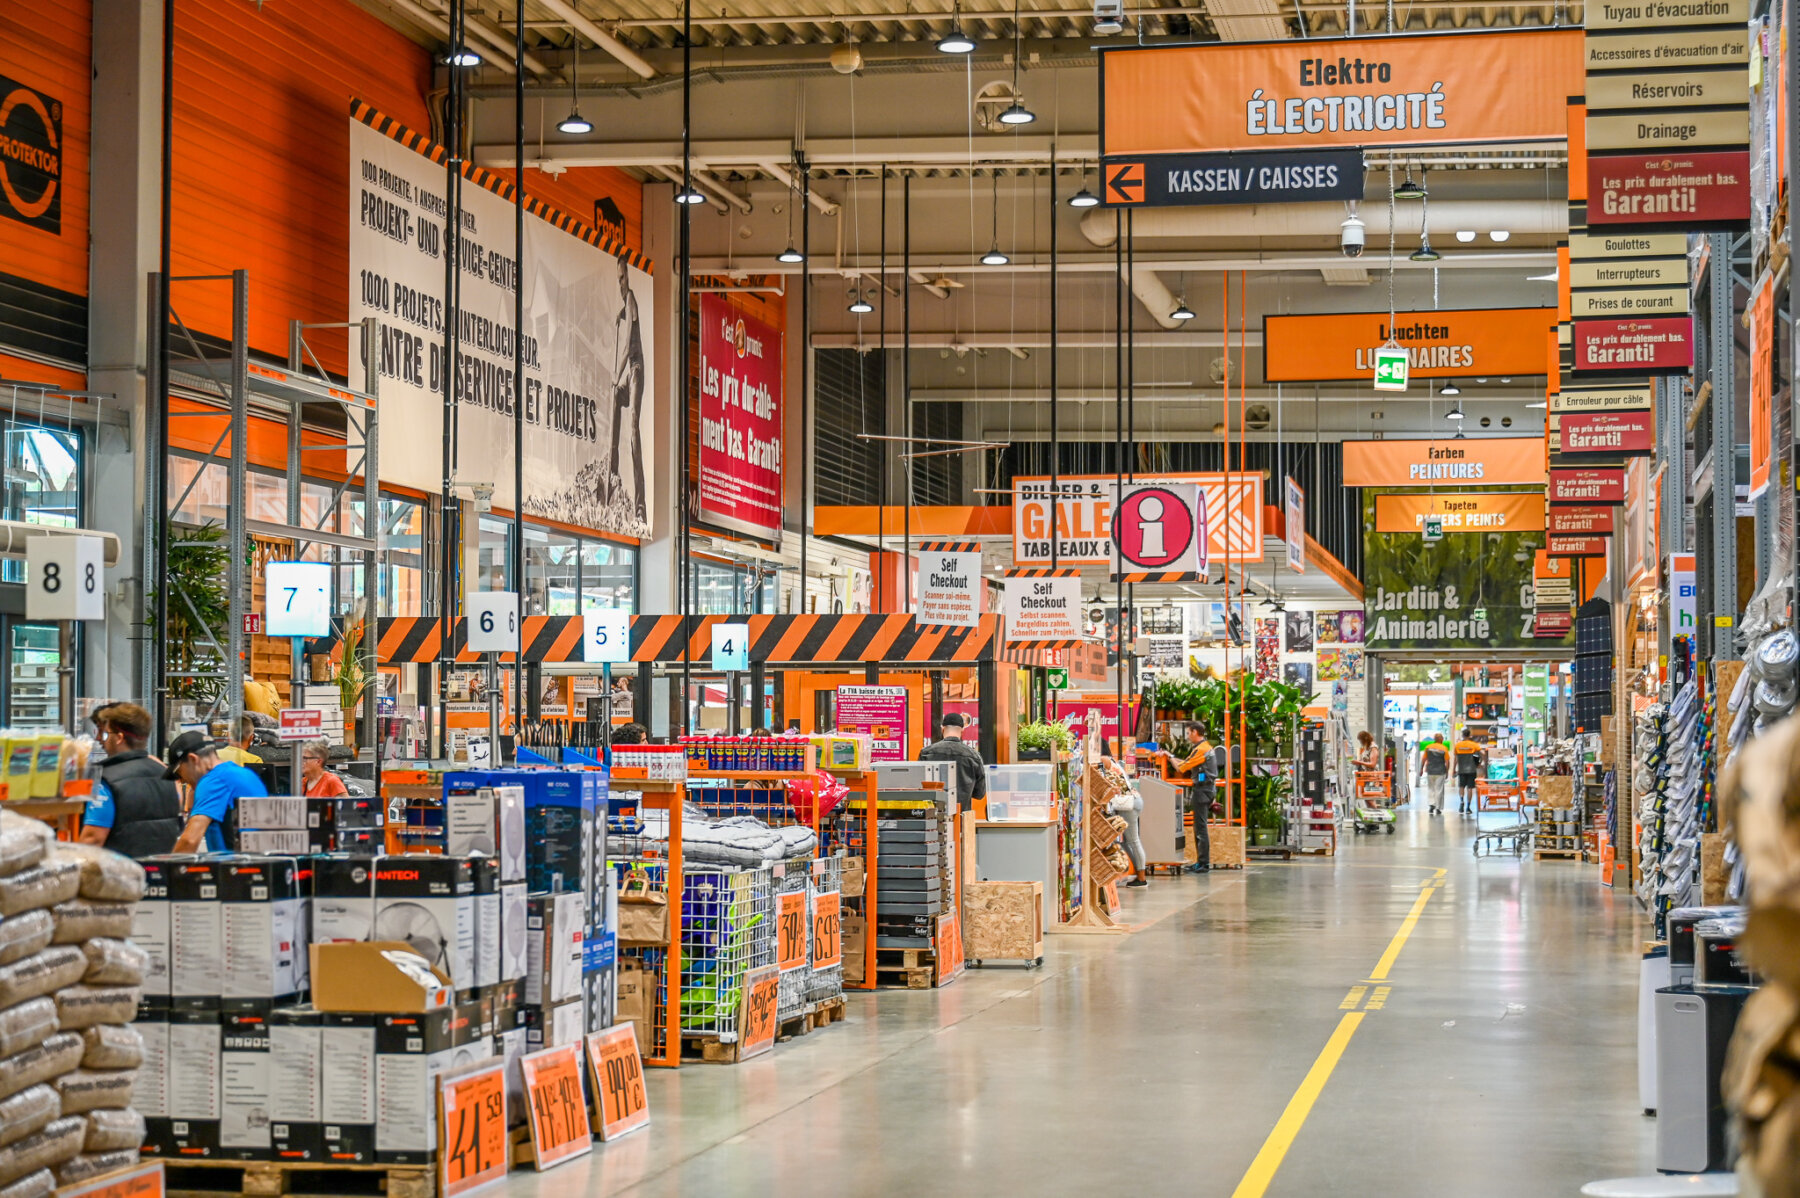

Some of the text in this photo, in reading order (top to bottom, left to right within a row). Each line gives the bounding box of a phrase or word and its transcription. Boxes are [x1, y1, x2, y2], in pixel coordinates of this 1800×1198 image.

[1603, 2, 1729, 22] Tuyau d'évacuation
[1590, 43, 1744, 61] Accessoires d'évacuation d'air
[1299, 57, 1391, 86] Elektro
[1632, 83, 1703, 99] Réservoirs
[1246, 81, 1446, 135] ÉLECTRICITÉ
[1637, 123, 1697, 140] Drainage
[361, 159, 378, 184] 1000
[379, 167, 412, 201] PROJEKTE.
[1167, 165, 1338, 193] KASSEN / CAISSES
[1603, 173, 1738, 191] Les prix durablement bas.
[1603, 187, 1696, 215] Garanti!
[361, 188, 414, 245] PROJEKT-
[417, 215, 439, 259] UND
[1605, 239, 1651, 251] Goulottes
[1596, 268, 1660, 280] Interrupteurs
[360, 269, 389, 313] 1000
[394, 282, 446, 334] PROJETS.
[1588, 296, 1674, 309] Prises de courant
[1379, 323, 1449, 341] Leuchten
[1586, 333, 1685, 346] Les prix durablement bas.
[1355, 345, 1473, 370] LUNAIRES
[1587, 344, 1655, 364] Garanti!
[702, 354, 777, 421] Les prix durable-
[1566, 396, 1602, 406] Enrouleur
[1604, 397, 1621, 406] pour
[1623, 394, 1644, 404] câble
[526, 377, 542, 423] ET
[547, 384, 597, 442] PROJETS
[1568, 425, 1580, 433] Les
[1581, 425, 1593, 434] prix
[702, 416, 780, 475] ment bas. Garanti!
[1569, 431, 1622, 447] Garanti!
[1428, 447, 1465, 459] Farben
[1409, 462, 1484, 479] PEINTURES
[1557, 484, 1600, 497] Garanti!
[1443, 500, 1477, 512] Tapeten
[1465, 512, 1505, 526] PEINTS
[1555, 519, 1592, 530] Garanti!
[1551, 541, 1585, 551] Garanti!
[941, 558, 957, 572] Self
[1547, 557, 1560, 574] 4
[42, 562, 95, 593] 8 8
[930, 573, 968, 589] Checkout
[924, 590, 945, 601] Scanner
[1034, 582, 1053, 595] Self
[283, 587, 297, 612] 7
[922, 600, 973, 613] Payer sans espèces.
[1021, 596, 1067, 609] Checkout
[1374, 585, 1460, 611] Jardin &
[480, 611, 515, 633] 6 6
[924, 611, 935, 620] Plus
[936, 612, 946, 621] vite
[953, 613, 969, 622] projet.
[1020, 611, 1039, 619] Selbst
[1011, 629, 1038, 637] Schneller
[1053, 628, 1077, 637] Projekt.
[1016, 620, 1072, 629] Bargeldlos zahlen.
[1374, 614, 1490, 640] Animalerie
[595, 625, 607, 645] 5
[721, 638, 734, 656] 4
